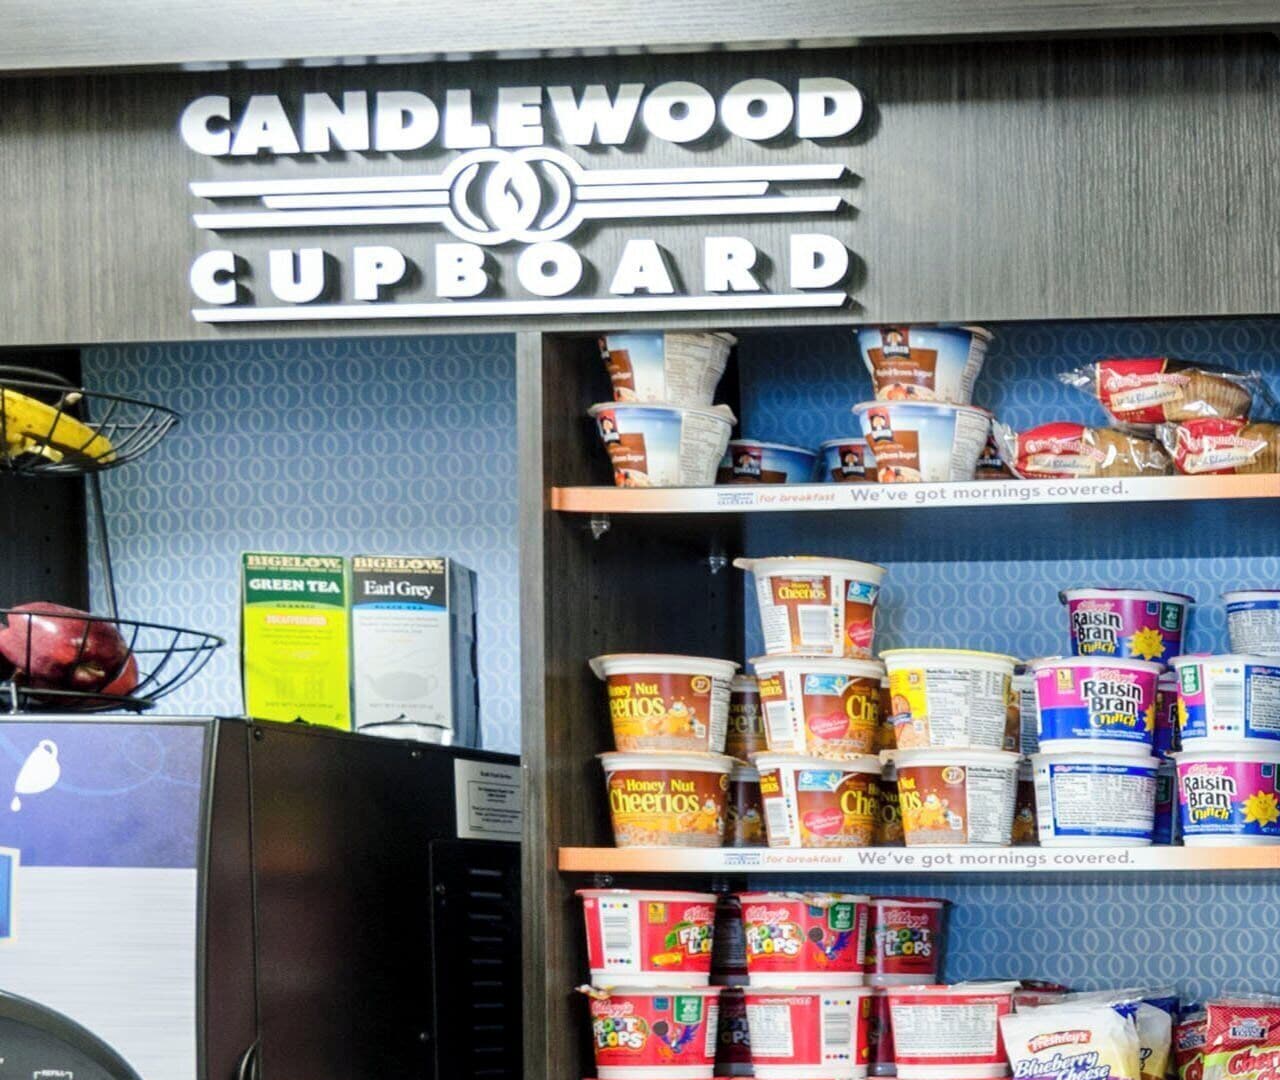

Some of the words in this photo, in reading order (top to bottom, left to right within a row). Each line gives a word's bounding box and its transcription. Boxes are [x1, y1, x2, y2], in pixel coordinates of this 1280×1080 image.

[179, 77, 864, 156] CANDLEWOOD
[189, 233, 850, 304] CUPBOARD
[850, 488, 909, 502] We've
[914, 488, 945, 504] got
[953, 485, 1041, 501] mornings
[1046, 481, 1130, 497] covered.
[247, 555, 340, 569] BIGELOW
[249, 578, 305, 592] GREEN
[307, 579, 341, 593] TEA
[363, 579, 395, 595] Earl
[396, 581, 434, 599] Grey
[1083, 680, 1142, 699] Raisin
[1091, 697, 1137, 716] Bran
[1089, 711, 1137, 728] Crunch
[626, 778, 666, 793] Honey
[671, 779, 696, 793] Nut
[610, 788, 700, 815] Cheerios
[857, 852, 915, 865] We've
[921, 853, 953, 869] got
[959, 851, 1047, 868] mornings
[1053, 850, 1135, 865] covered.
[1013, 1051, 1099, 1079] Blueberry
